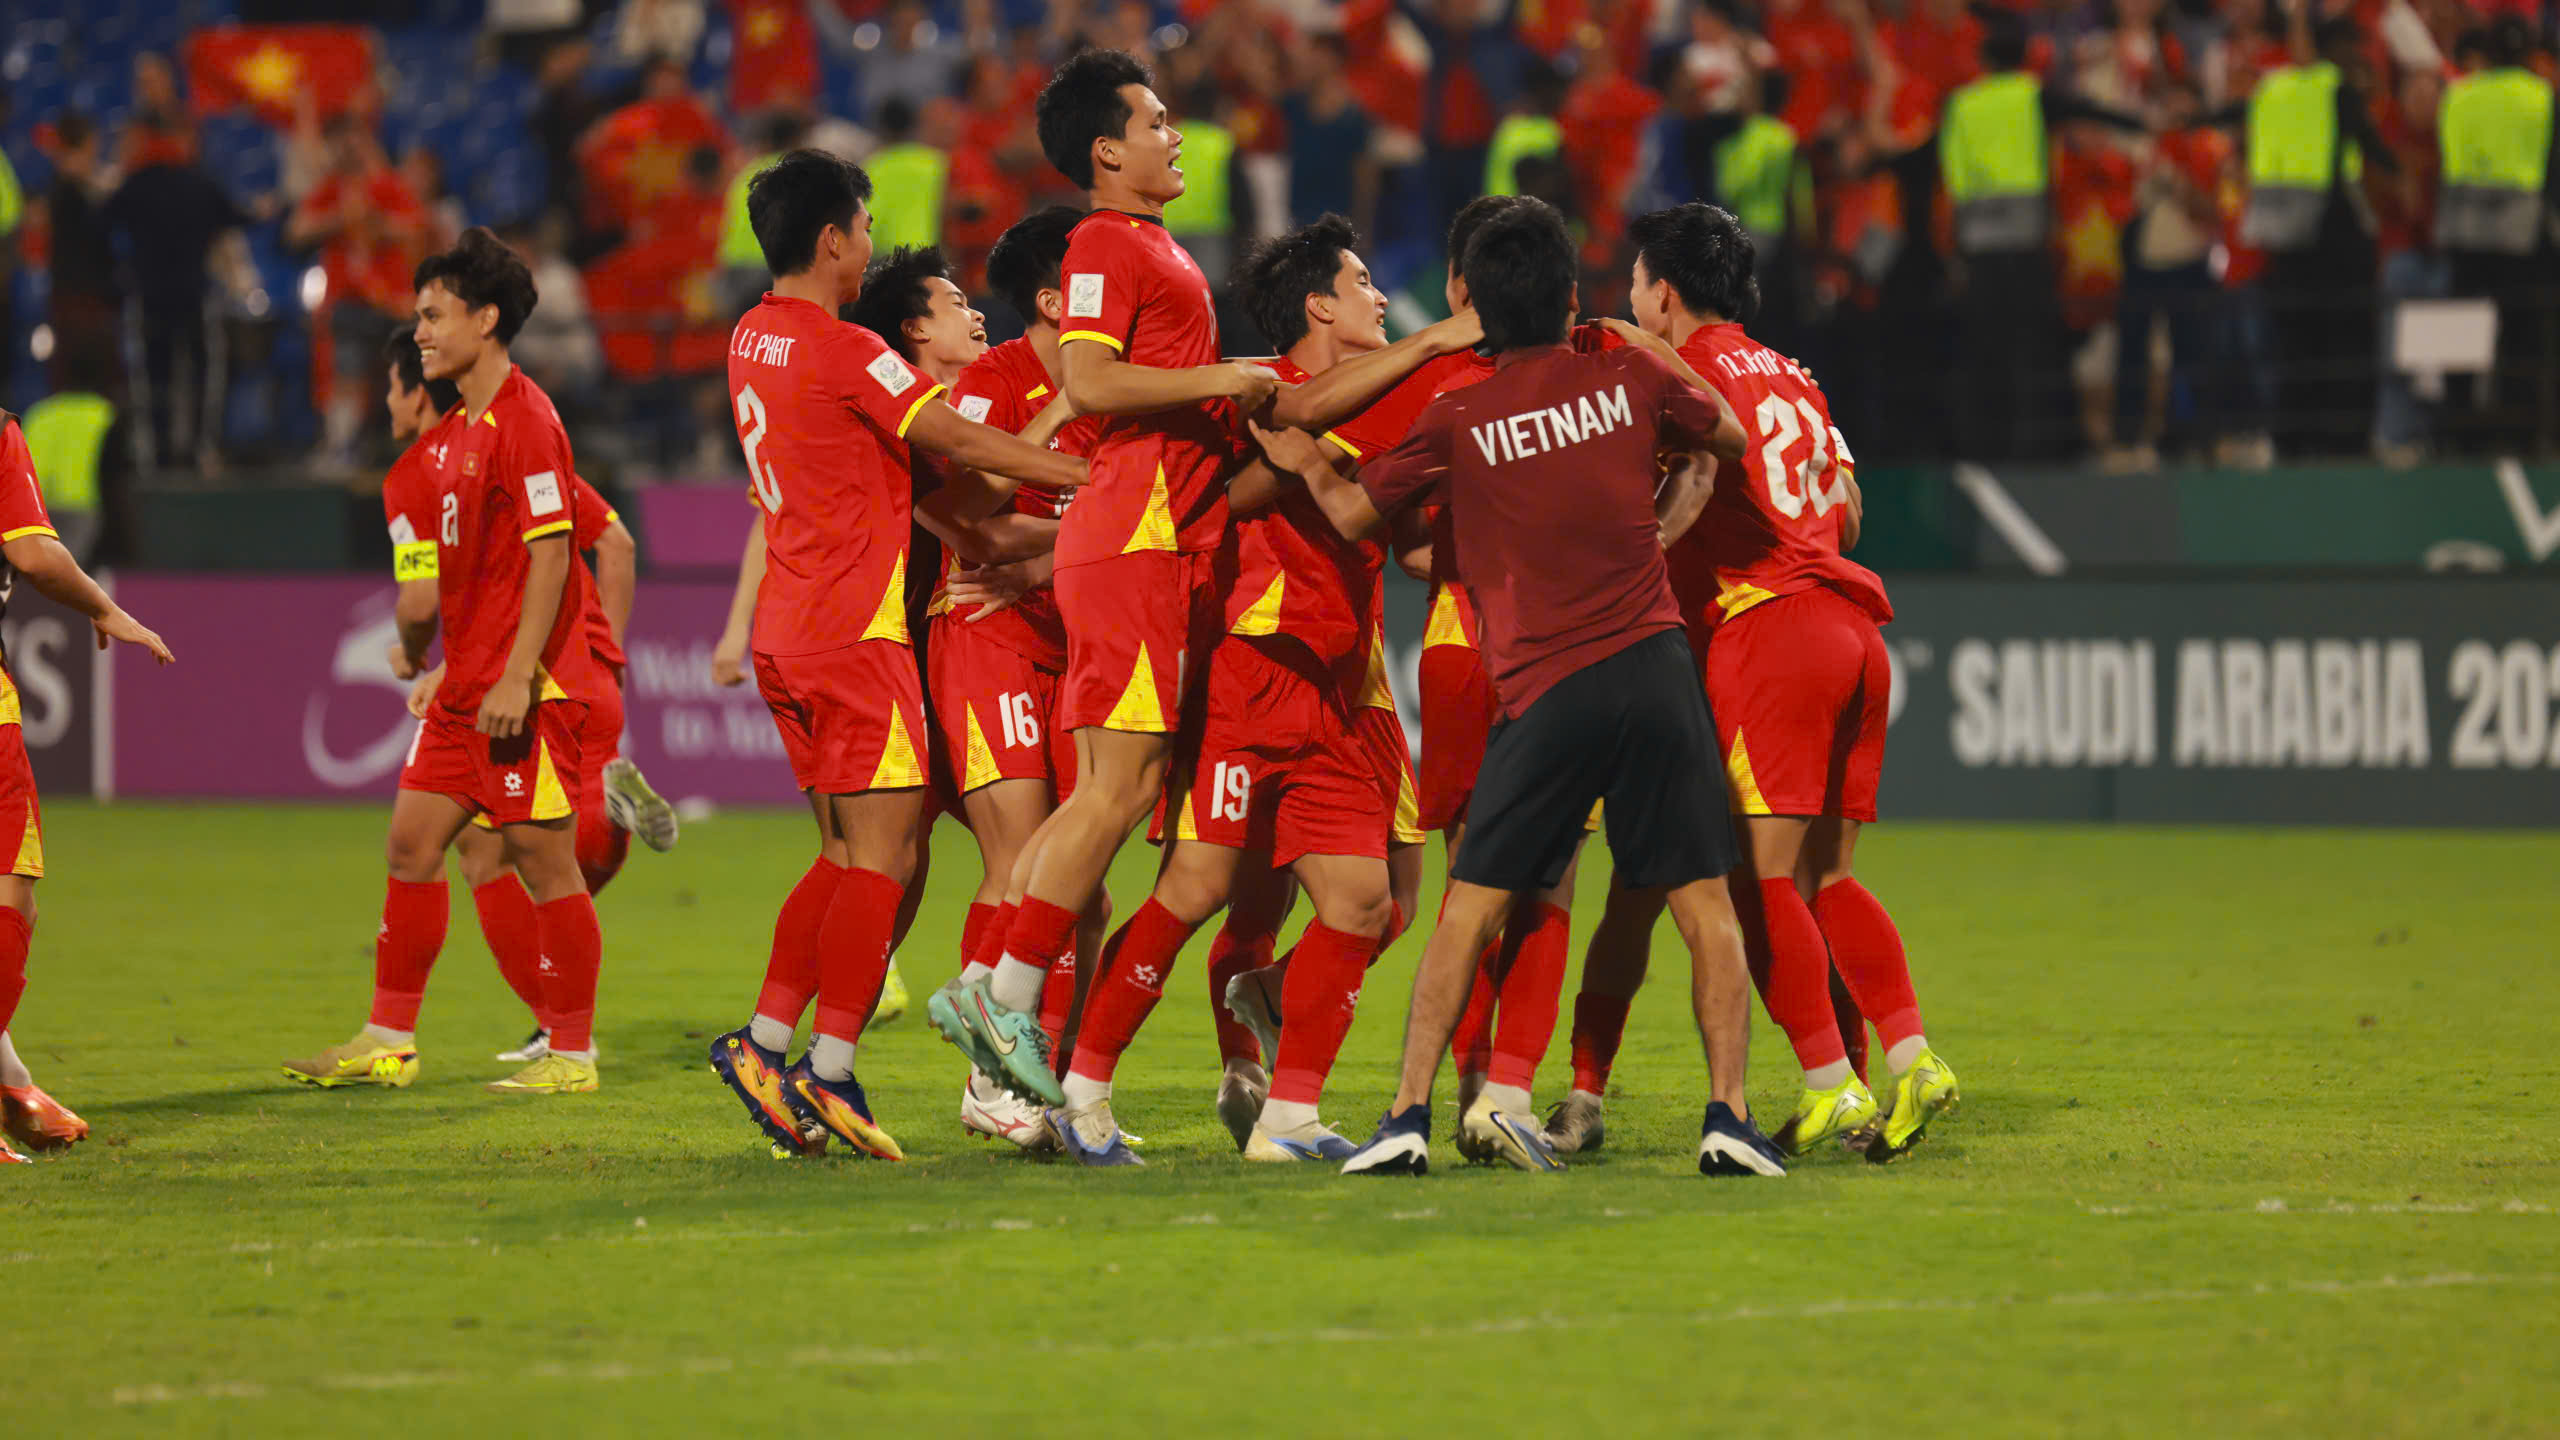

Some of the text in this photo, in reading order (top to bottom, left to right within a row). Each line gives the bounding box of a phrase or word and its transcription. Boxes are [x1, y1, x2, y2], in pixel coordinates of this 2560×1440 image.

[753, 333, 796, 367] PHAT
[1470, 384, 1633, 466] VIETNAM
[999, 691, 1039, 749] 16
[1949, 637, 2158, 768] SAUDI
[2172, 638, 2431, 768] ARABIA
[2448, 638, 2560, 770] 20
[1211, 760, 1251, 822] 19
